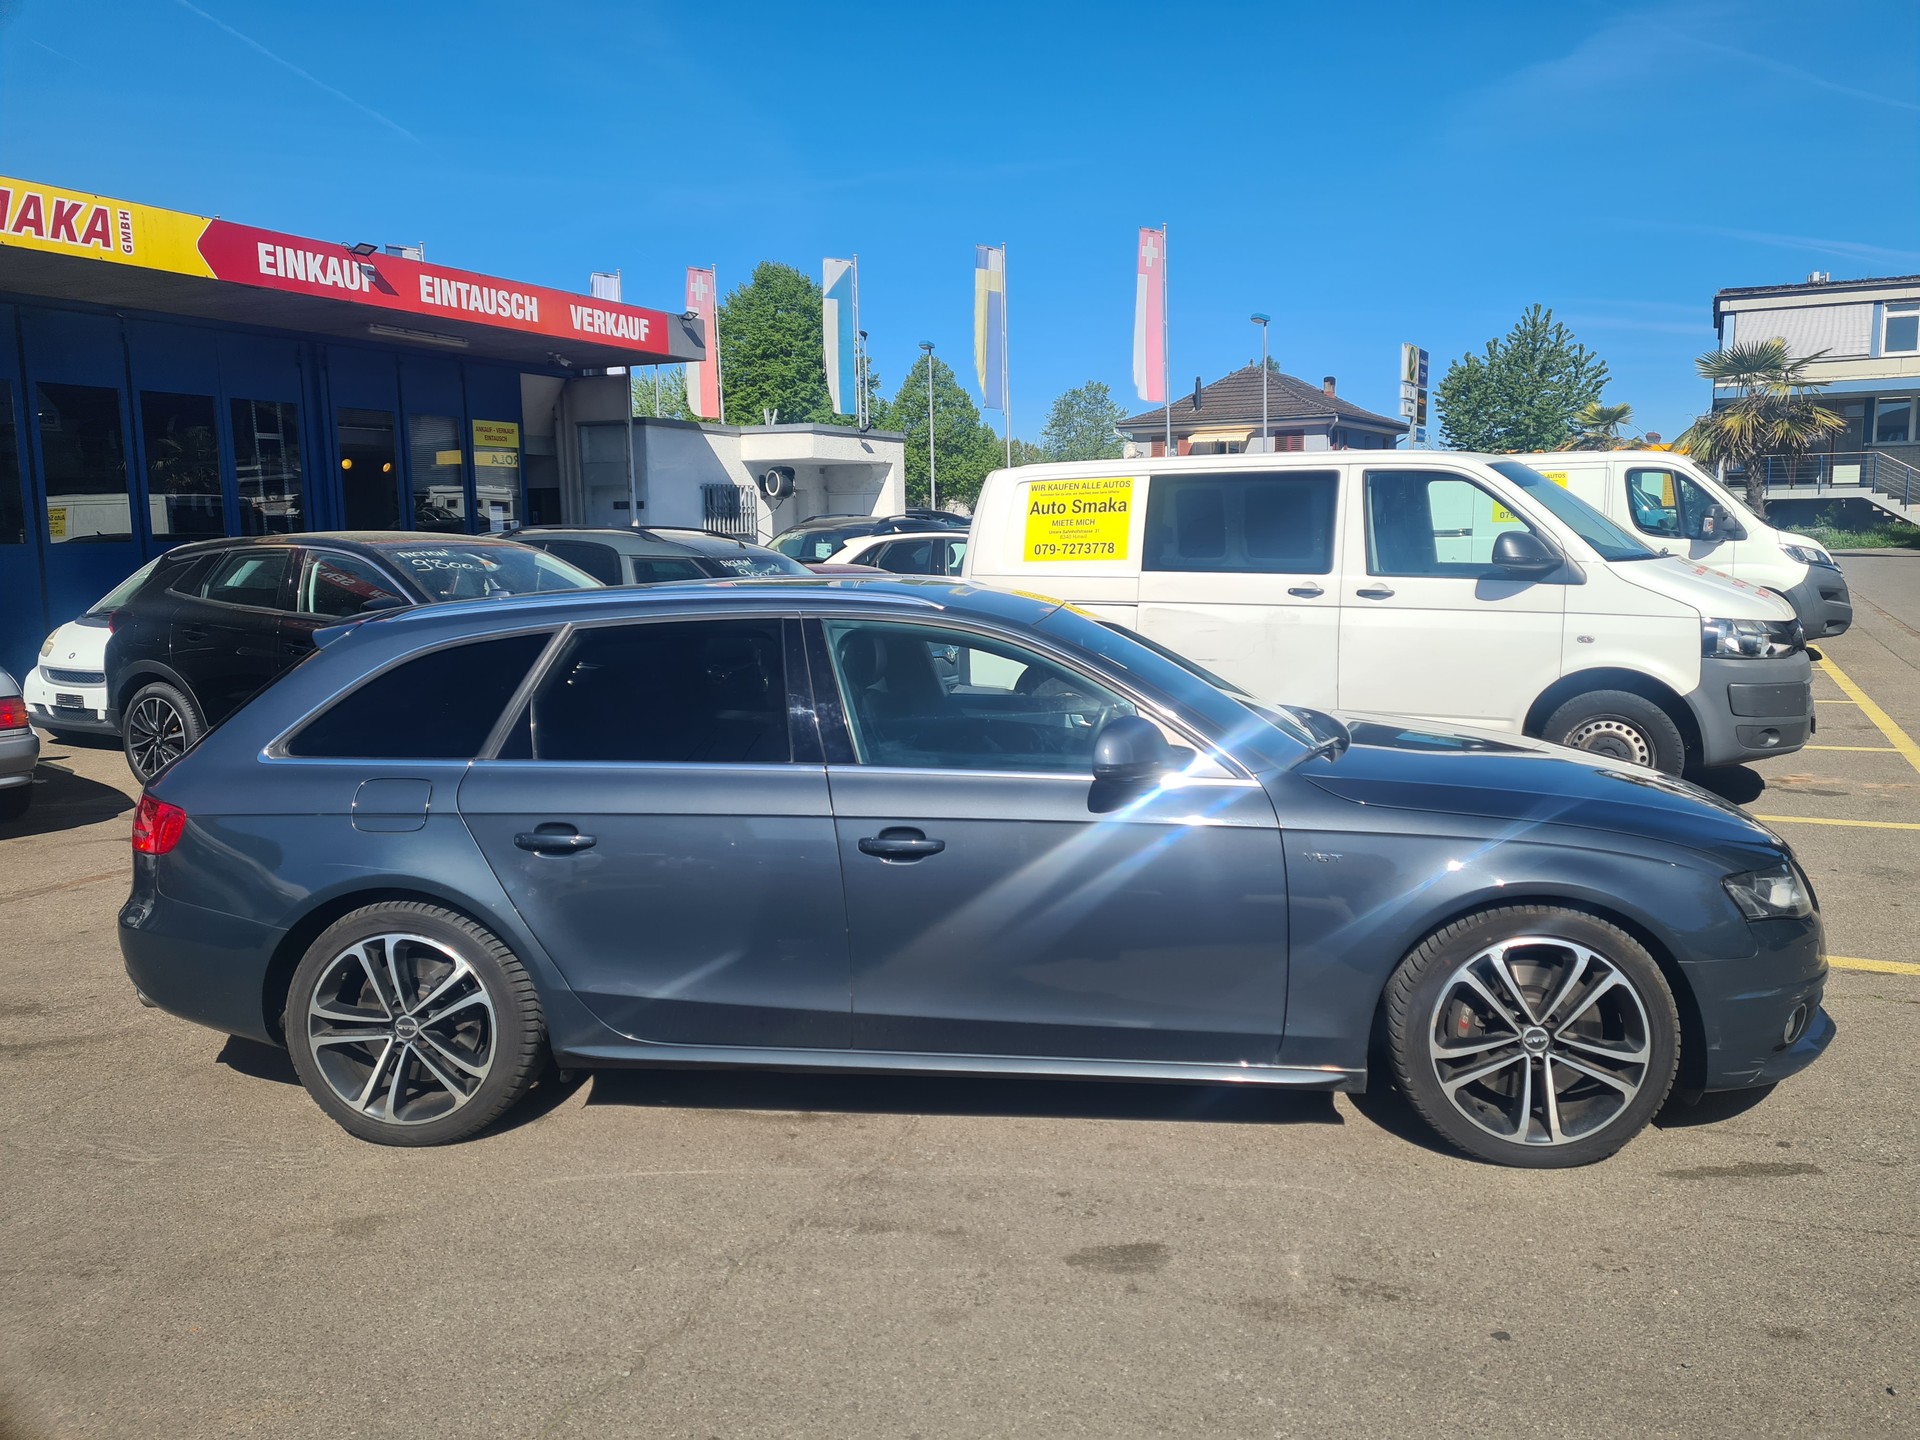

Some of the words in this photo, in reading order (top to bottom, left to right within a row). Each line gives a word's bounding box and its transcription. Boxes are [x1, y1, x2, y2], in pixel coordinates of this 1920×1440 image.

[119, 210, 132, 254] GMBH
[257, 241, 376, 293] EINKAUF
[419, 274, 539, 323] EINTAUSCH
[569, 304, 650, 342] VERKAUF
[1031, 484, 1046, 492] WIR
[1047, 482, 1080, 491] KAUFEN
[1081, 481, 1101, 490] ALLE
[1103, 480, 1131, 489] AUTOS
[1029, 501, 1067, 515] Auto
[1071, 497, 1127, 513] Smaka
[1051, 519, 1074, 527] MIETE
[1075, 518, 1096, 526] MICH
[1034, 542, 1115, 555] 079-7273778
